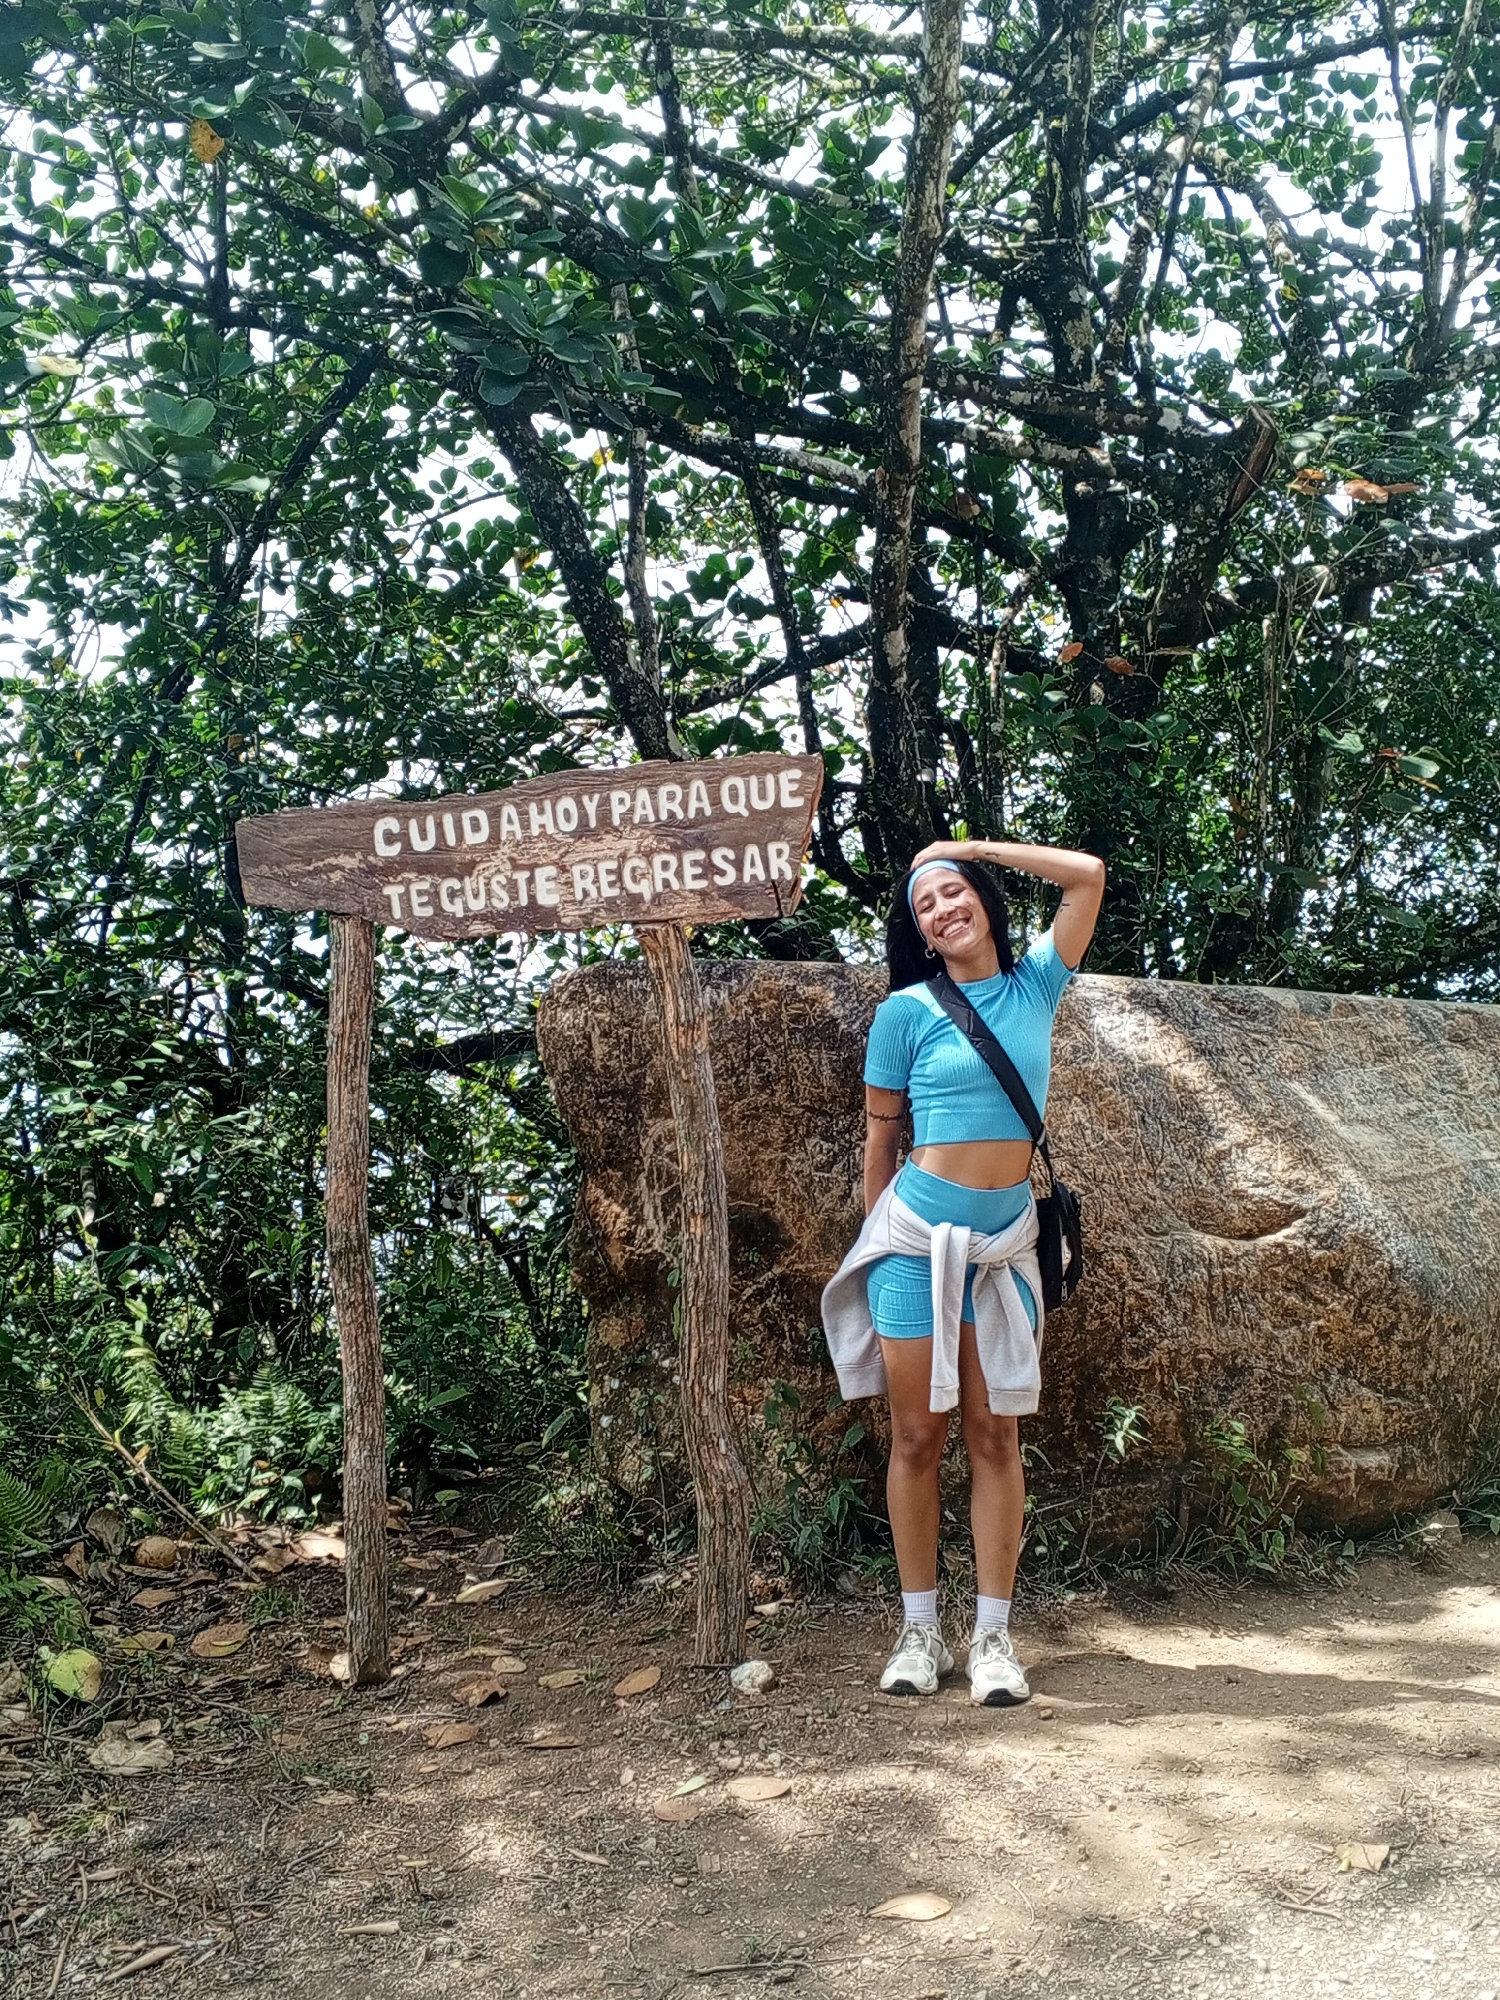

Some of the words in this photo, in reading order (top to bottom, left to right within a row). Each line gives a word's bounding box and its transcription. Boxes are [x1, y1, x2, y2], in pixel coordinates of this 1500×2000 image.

[373, 804, 522, 857] CUIDA
[528, 793, 599, 836] HOY
[609, 779, 712, 827] PARA
[720, 769, 805, 818] QUE
[382, 880, 434, 920] TE
[439, 865, 560, 918] GUSTE
[572, 841, 793, 902] REGRESAR
